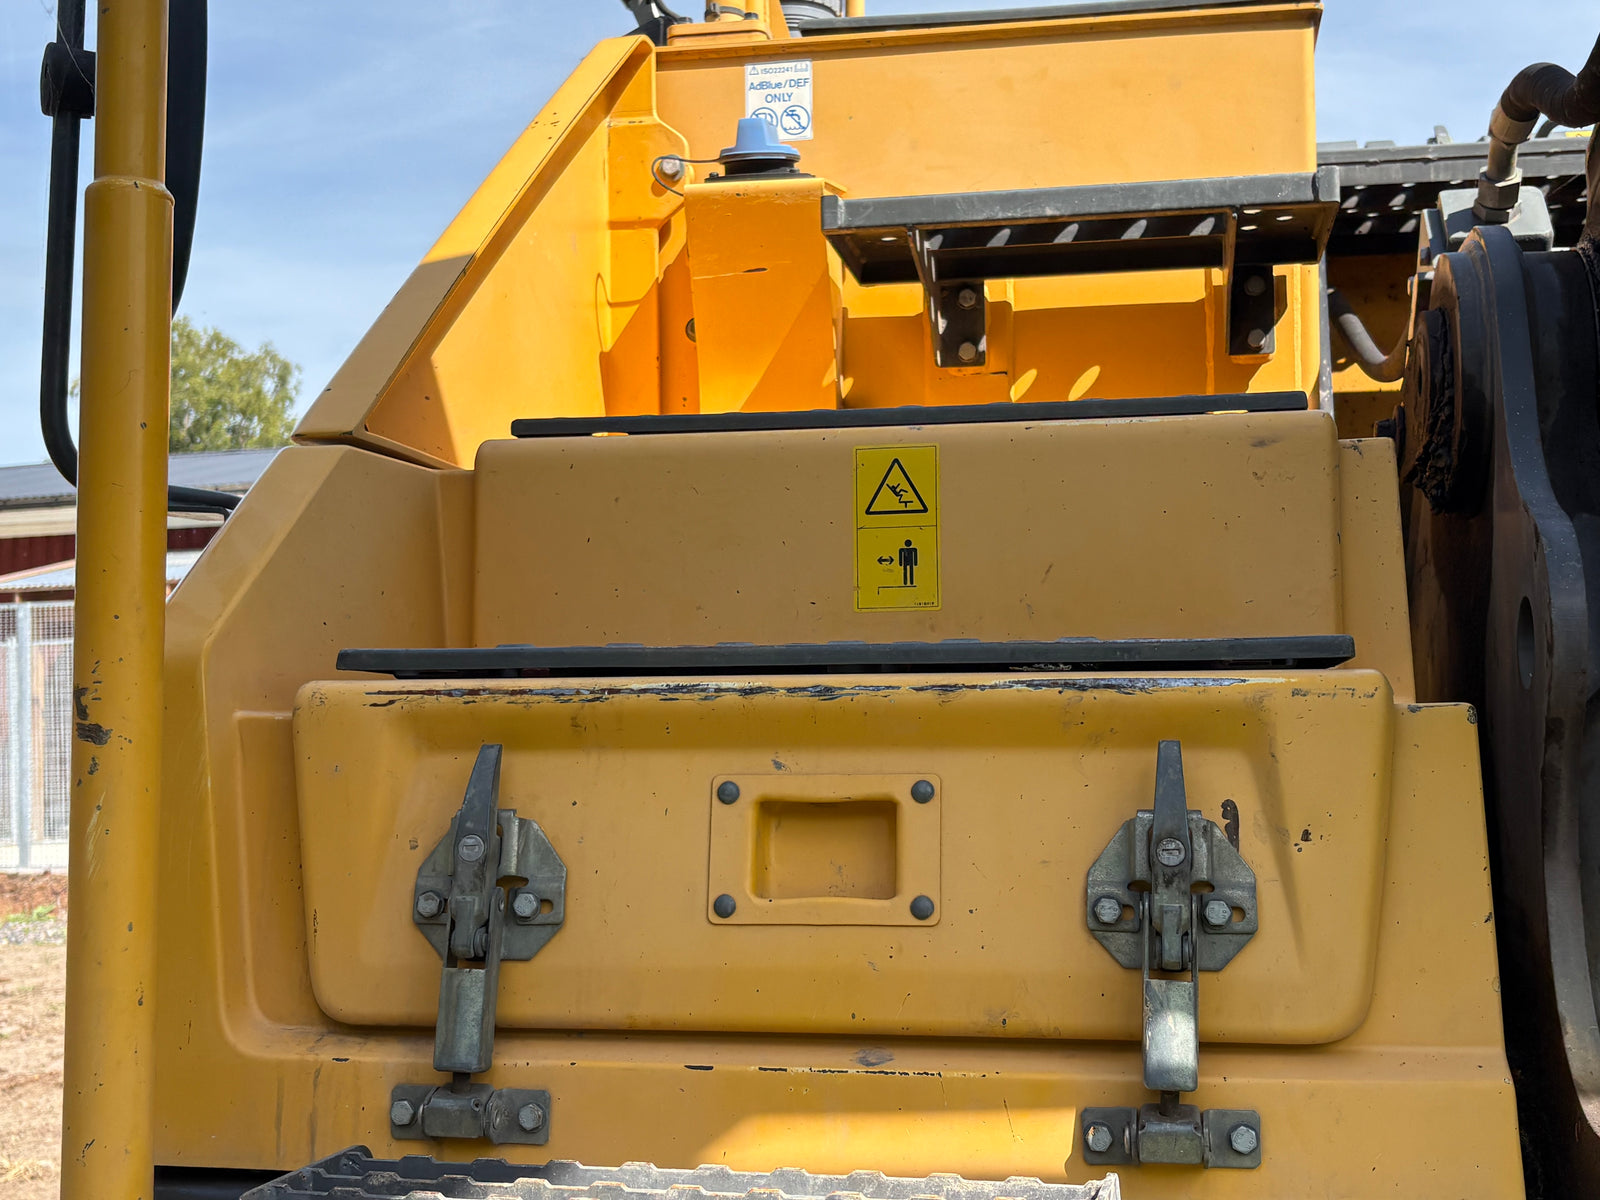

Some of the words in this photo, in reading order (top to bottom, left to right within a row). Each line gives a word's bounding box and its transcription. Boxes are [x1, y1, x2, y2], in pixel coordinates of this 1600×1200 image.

[761, 66, 793, 75] ISO22241
[749, 77, 810, 91] AdBlue/DEF
[764, 92, 794, 104] ONLY
